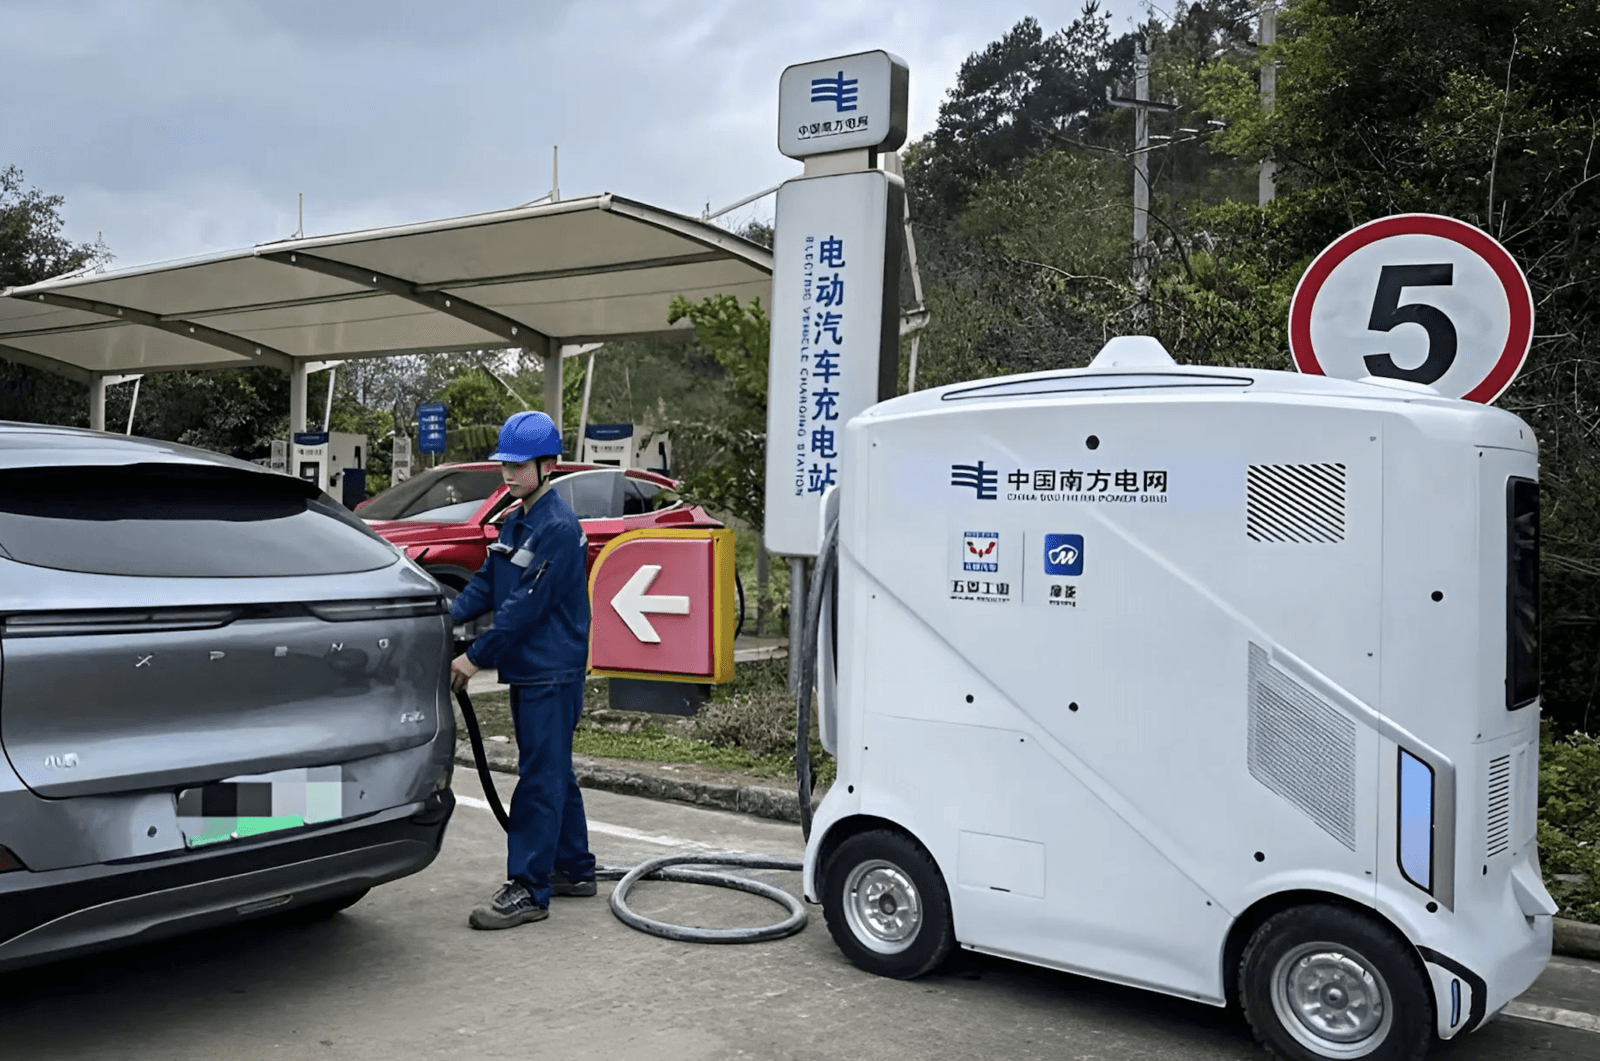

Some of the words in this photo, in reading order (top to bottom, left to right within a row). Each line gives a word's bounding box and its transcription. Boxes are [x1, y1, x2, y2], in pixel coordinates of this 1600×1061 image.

[808, 234, 845, 496] 电动汽车充电站
[1363, 263, 1457, 385] 5
[1007, 468, 1168, 493] 中国南方电网
